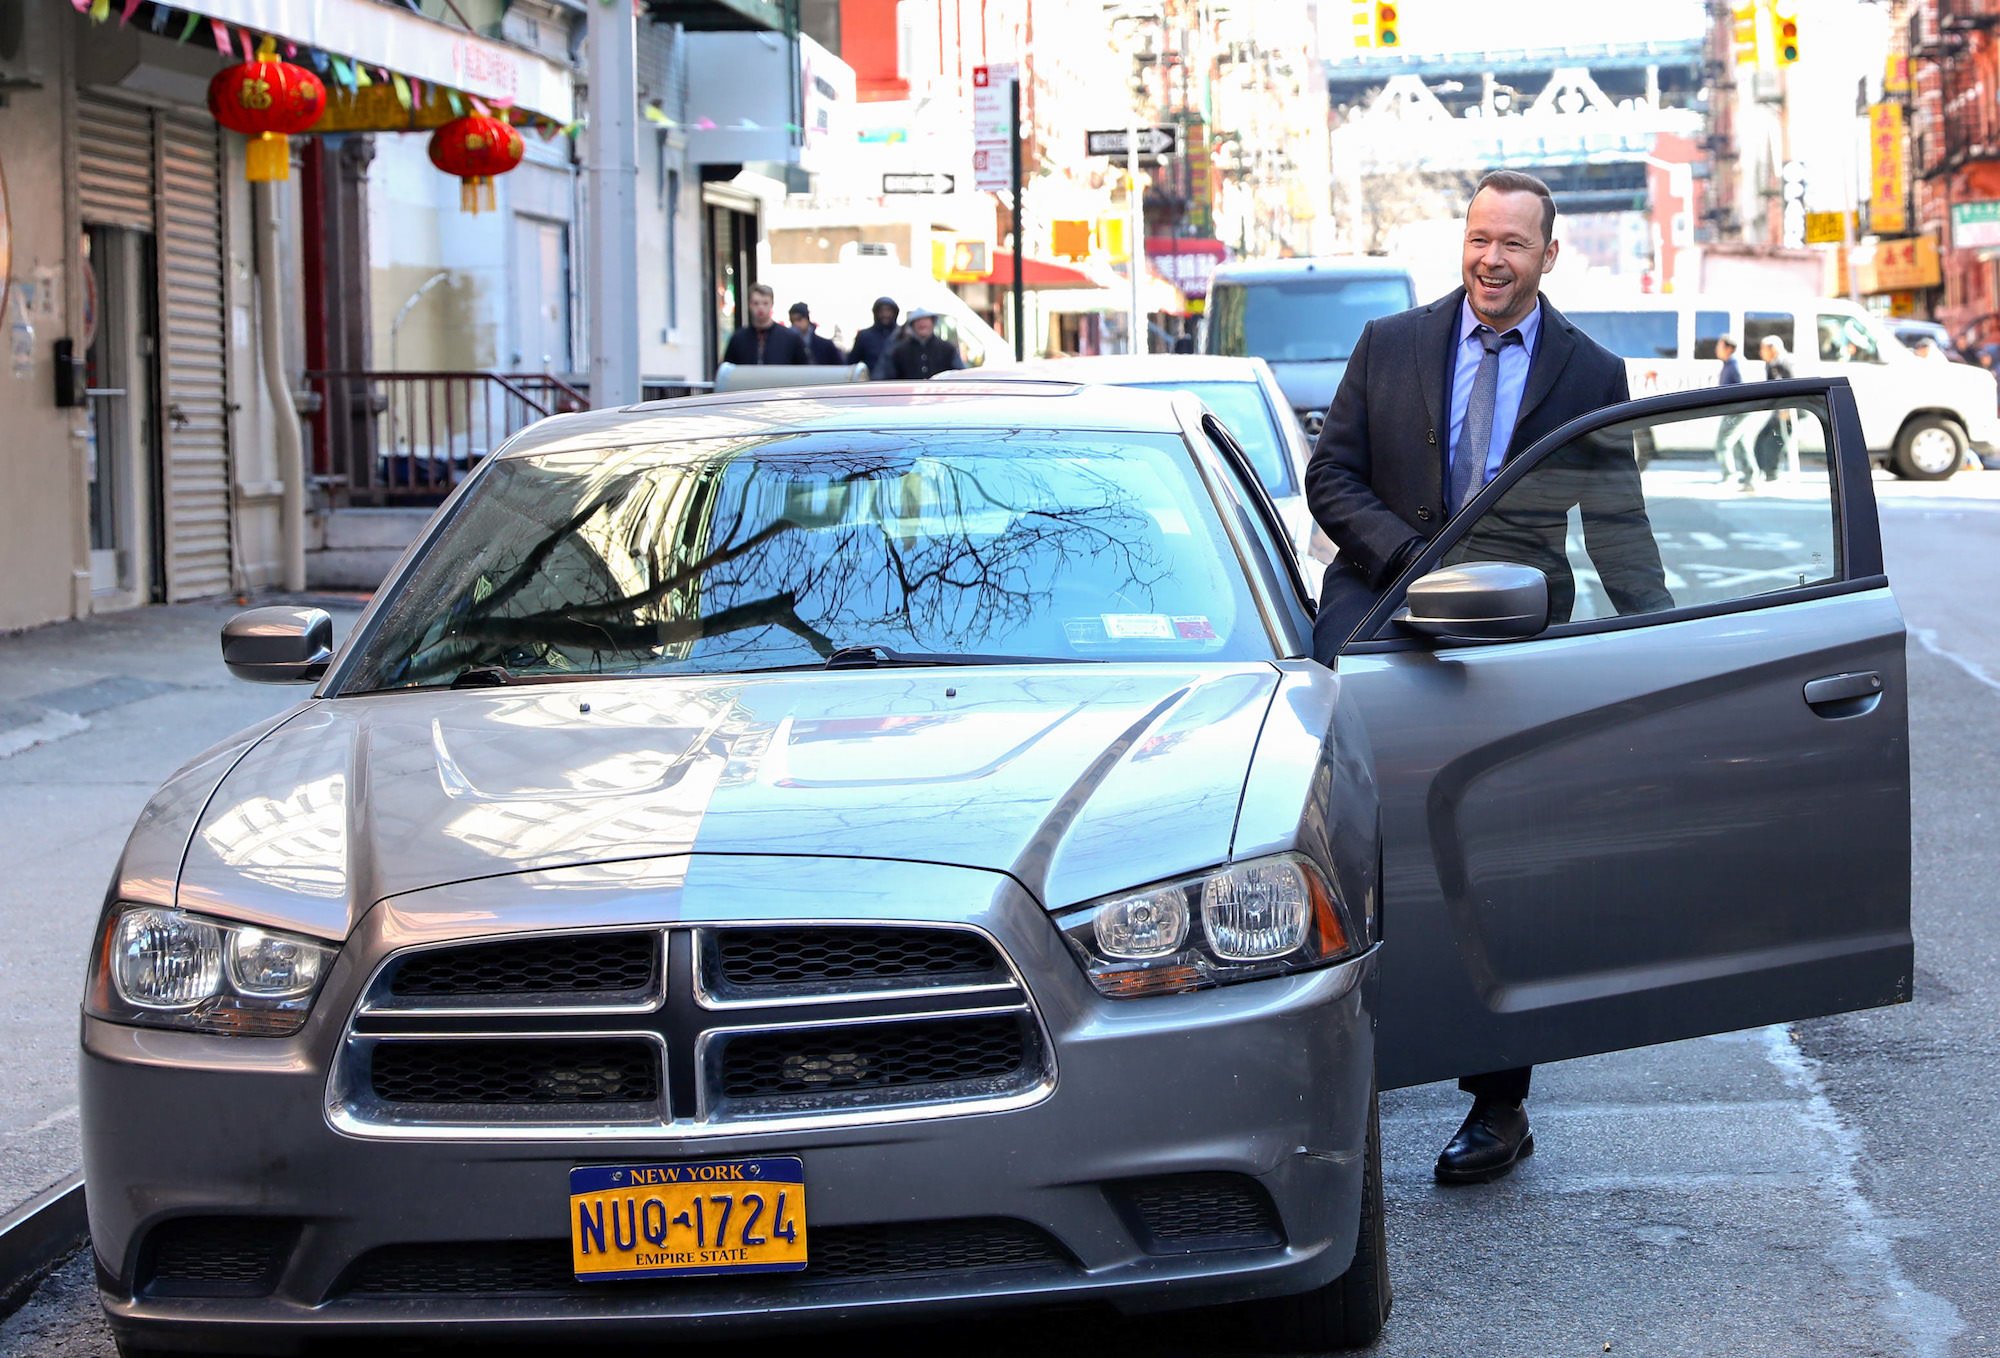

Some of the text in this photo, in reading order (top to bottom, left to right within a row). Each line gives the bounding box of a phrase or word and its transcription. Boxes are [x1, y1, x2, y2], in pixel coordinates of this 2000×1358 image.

[630, 1164, 745, 1185] NEW YORK
[635, 1248, 748, 1265] EMPIRE STATE
